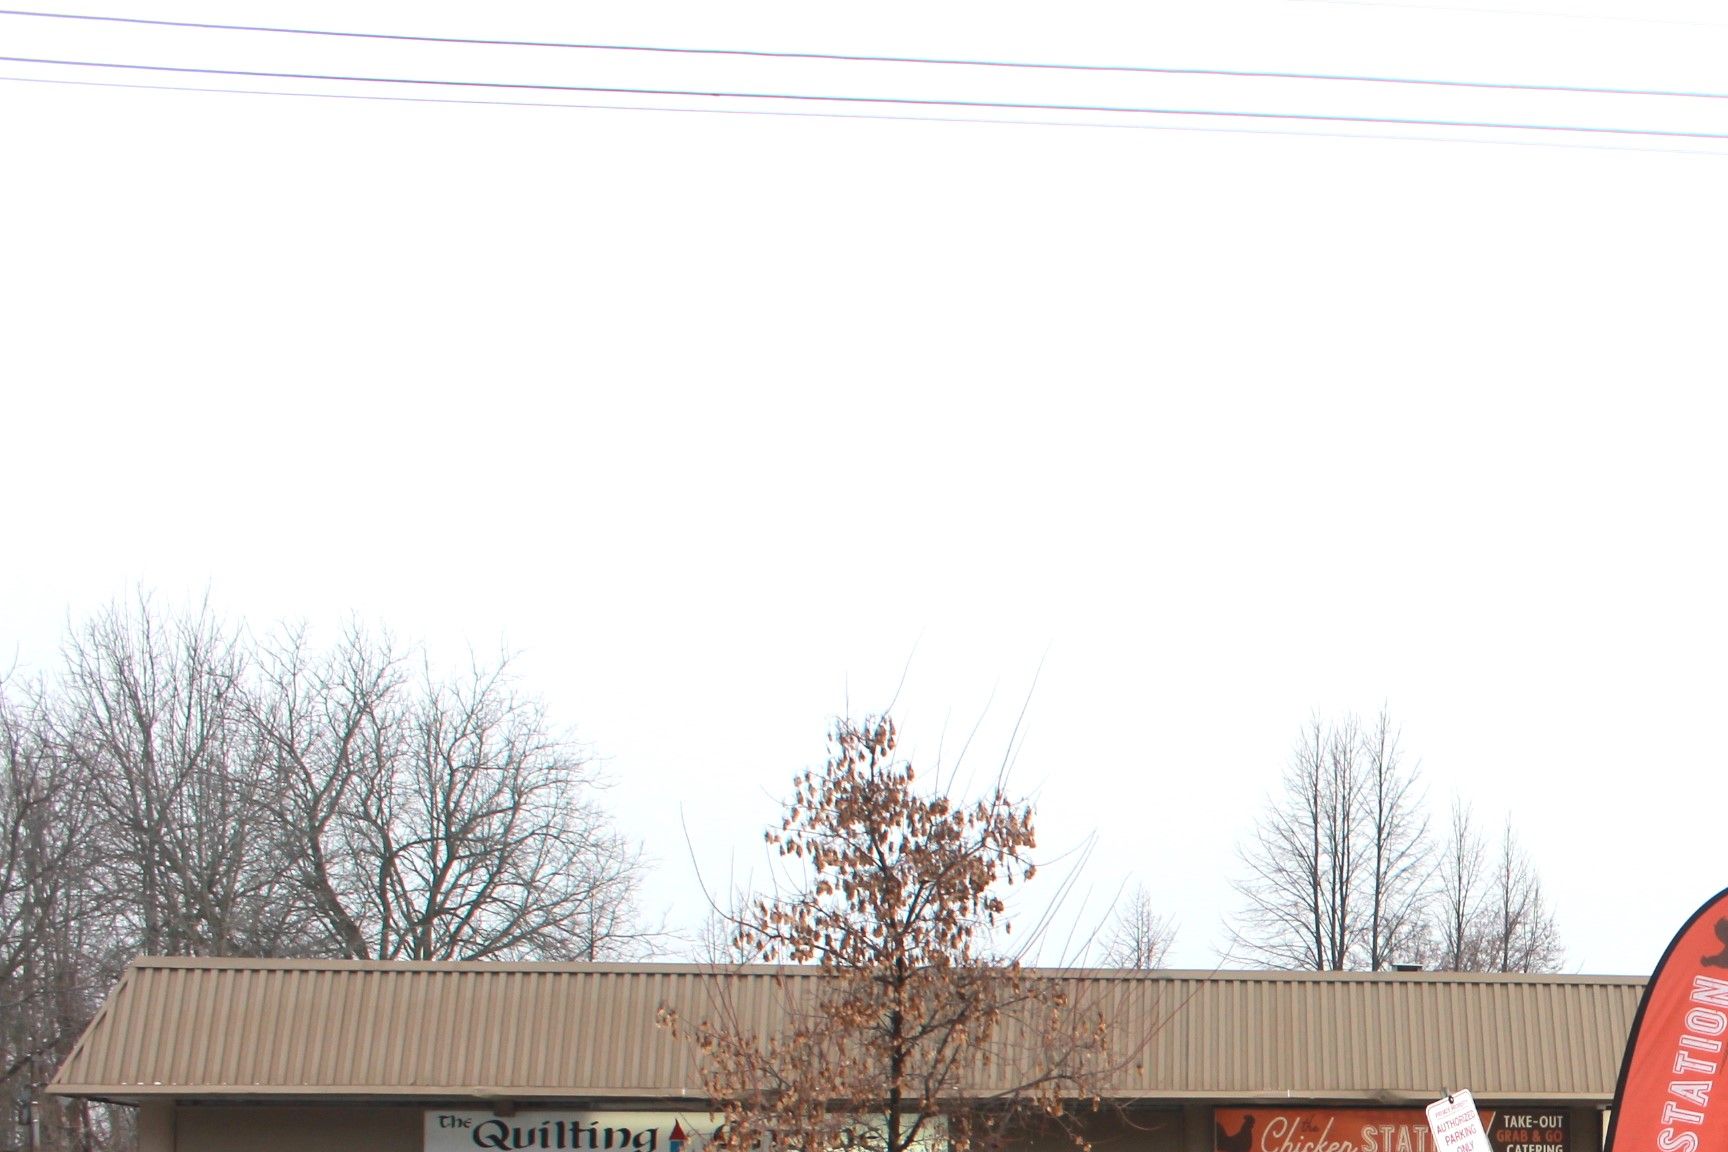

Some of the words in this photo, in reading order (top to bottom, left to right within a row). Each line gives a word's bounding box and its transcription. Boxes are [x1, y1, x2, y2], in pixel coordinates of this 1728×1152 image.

[1301, 1115, 1320, 1132] the
[1437, 1110, 1476, 1135] AUTHORIZED
[1504, 1115, 1563, 1128] TAKE-OUT
[1445, 1124, 1477, 1147] PARKING
[1497, 1130, 1528, 1142] GRAB
[1532, 1130, 1540, 1142] &
[1545, 1130, 1563, 1142] GO
